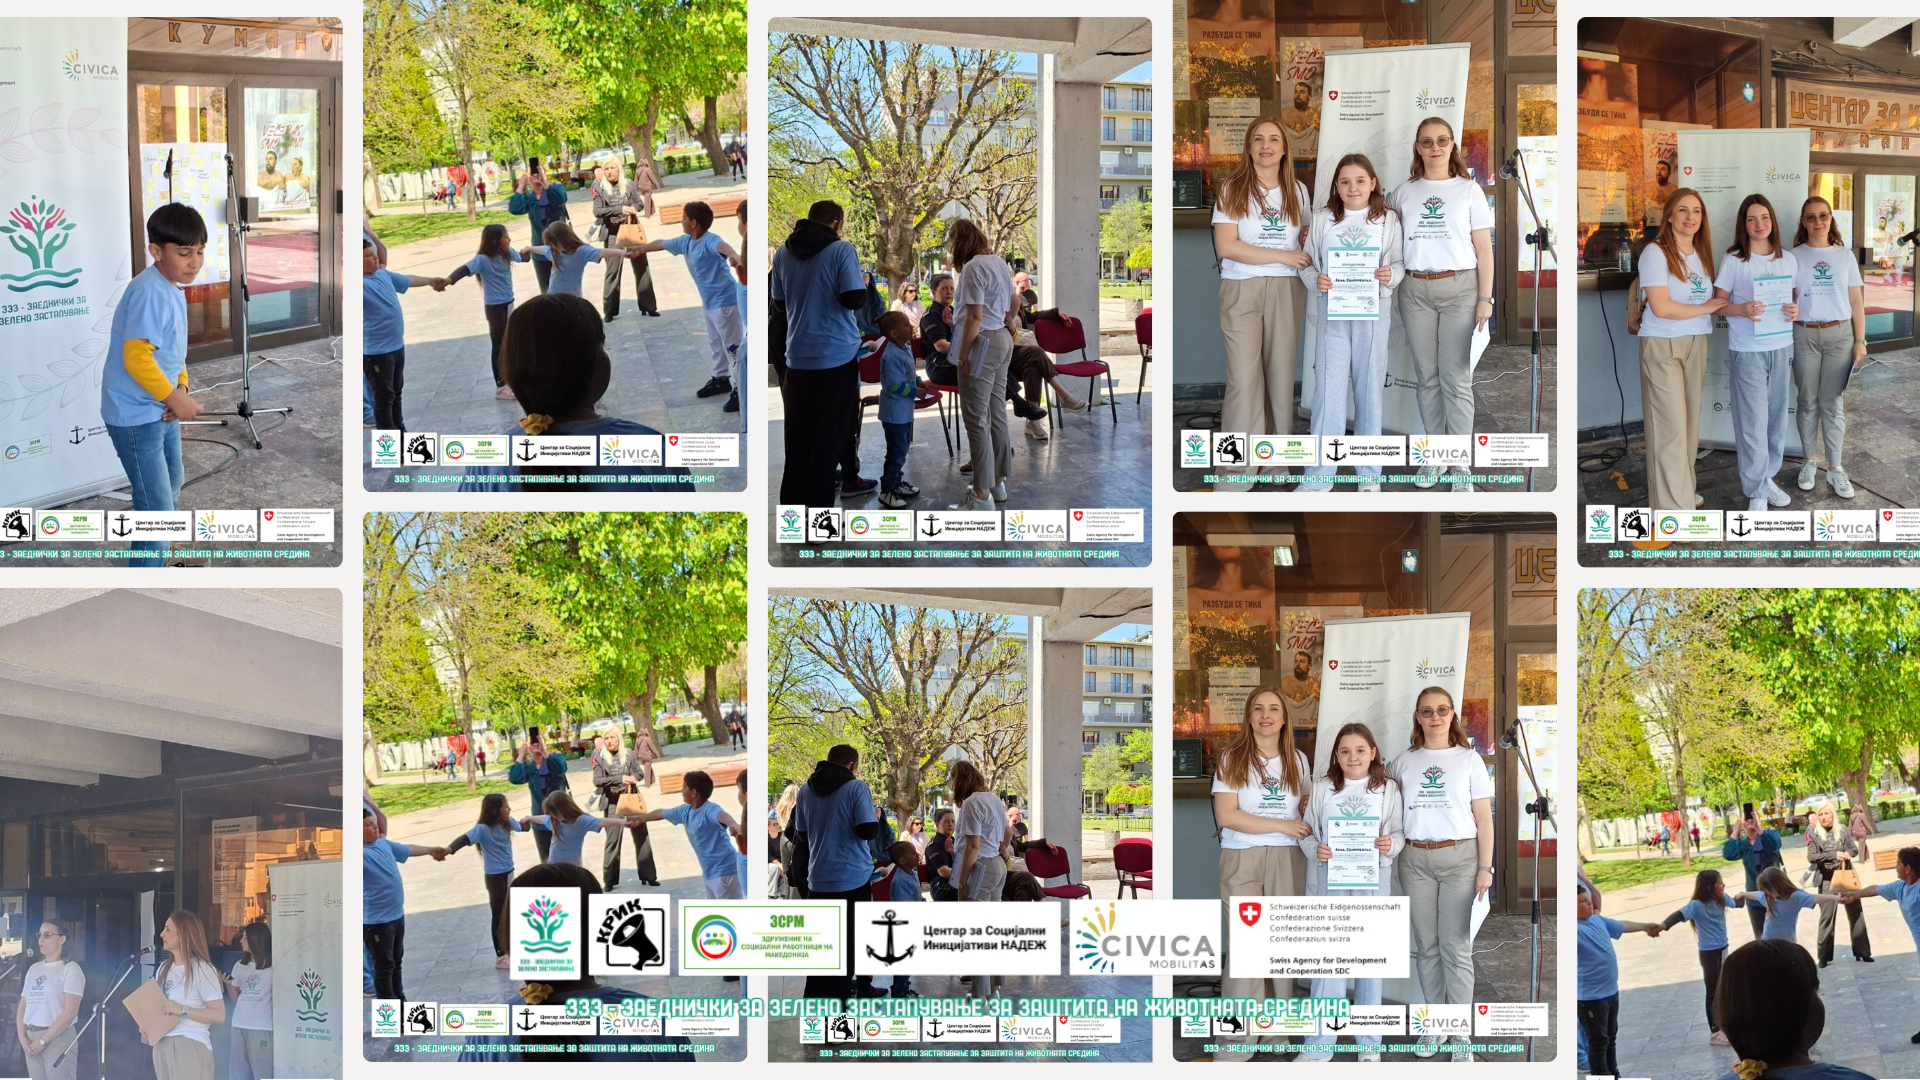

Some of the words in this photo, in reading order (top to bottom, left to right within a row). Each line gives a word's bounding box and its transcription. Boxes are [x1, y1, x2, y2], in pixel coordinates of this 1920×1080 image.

[1202, 31, 1233, 39] РАЗБУДИ
[1234, 31, 1243, 39] СЕ
[1244, 31, 1262, 39] ТИНА
[74, 64, 118, 75] CIVICA
[1286, 66, 1316, 80] SMO
[1423, 97, 1455, 105] CIVICA
[1601, 110, 1609, 118] СЕ
[1611, 111, 1626, 119] ТИНА
[1791, 91, 1870, 126] ЦЕНТАР
[1876, 102, 1900, 130] ЗА
[1650, 147, 1675, 160] SMO
[2, 304, 18, 314] 333
[27, 297, 74, 310] ЗАЕДНИЧКИ
[77, 296, 86, 304] ЗА
[0, 314, 32, 326] ЗЕЛЕНО
[34, 307, 90, 321] ЗАСТАПУВАЊЕ
[1202, 600, 1234, 609] РАЗБУДИ
[1235, 600, 1243, 608] СЕ
[1244, 600, 1262, 608] ТИНА
[1287, 636, 1316, 650] SMO
[1423, 666, 1455, 674] CIVICA
